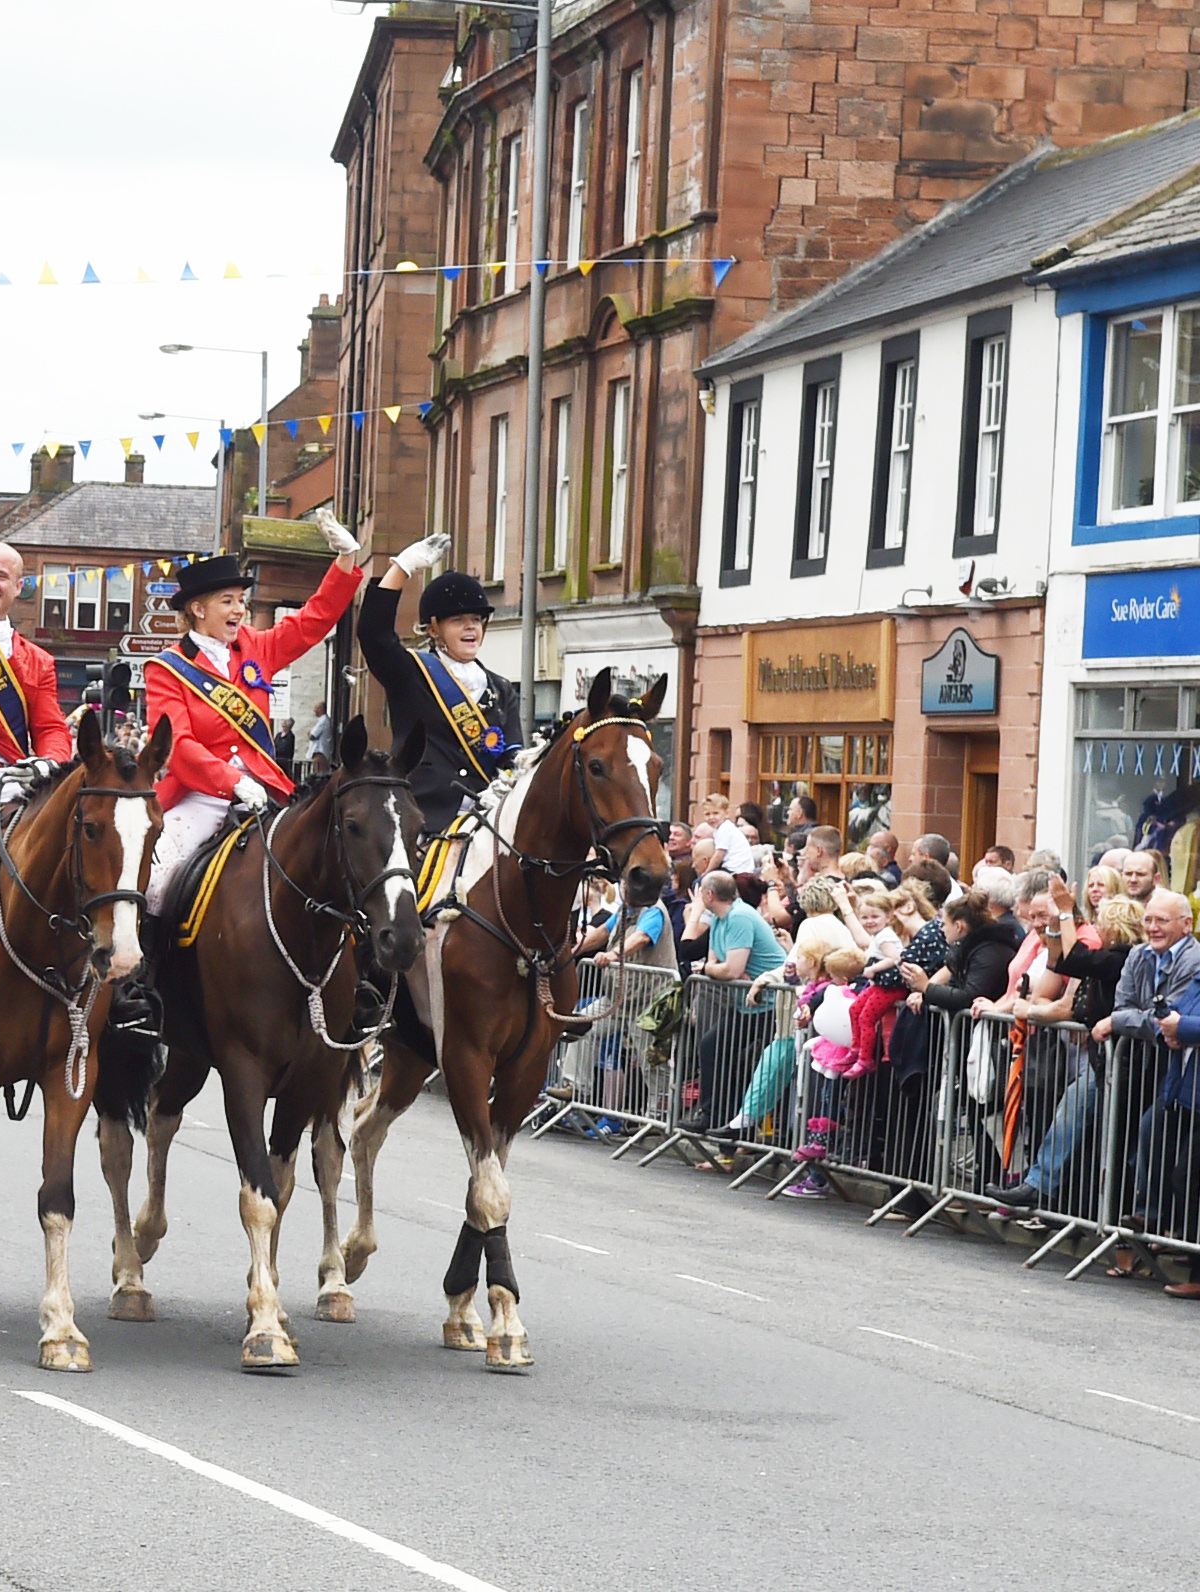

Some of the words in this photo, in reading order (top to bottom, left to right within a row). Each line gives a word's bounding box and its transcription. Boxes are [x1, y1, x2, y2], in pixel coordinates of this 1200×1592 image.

[1111, 598, 1128, 622] Sue
[1129, 598, 1155, 624] Ryder
[1155, 595, 1176, 620] Care
[154, 620, 177, 628] Cinem
[131, 638, 163, 646] Annandale
